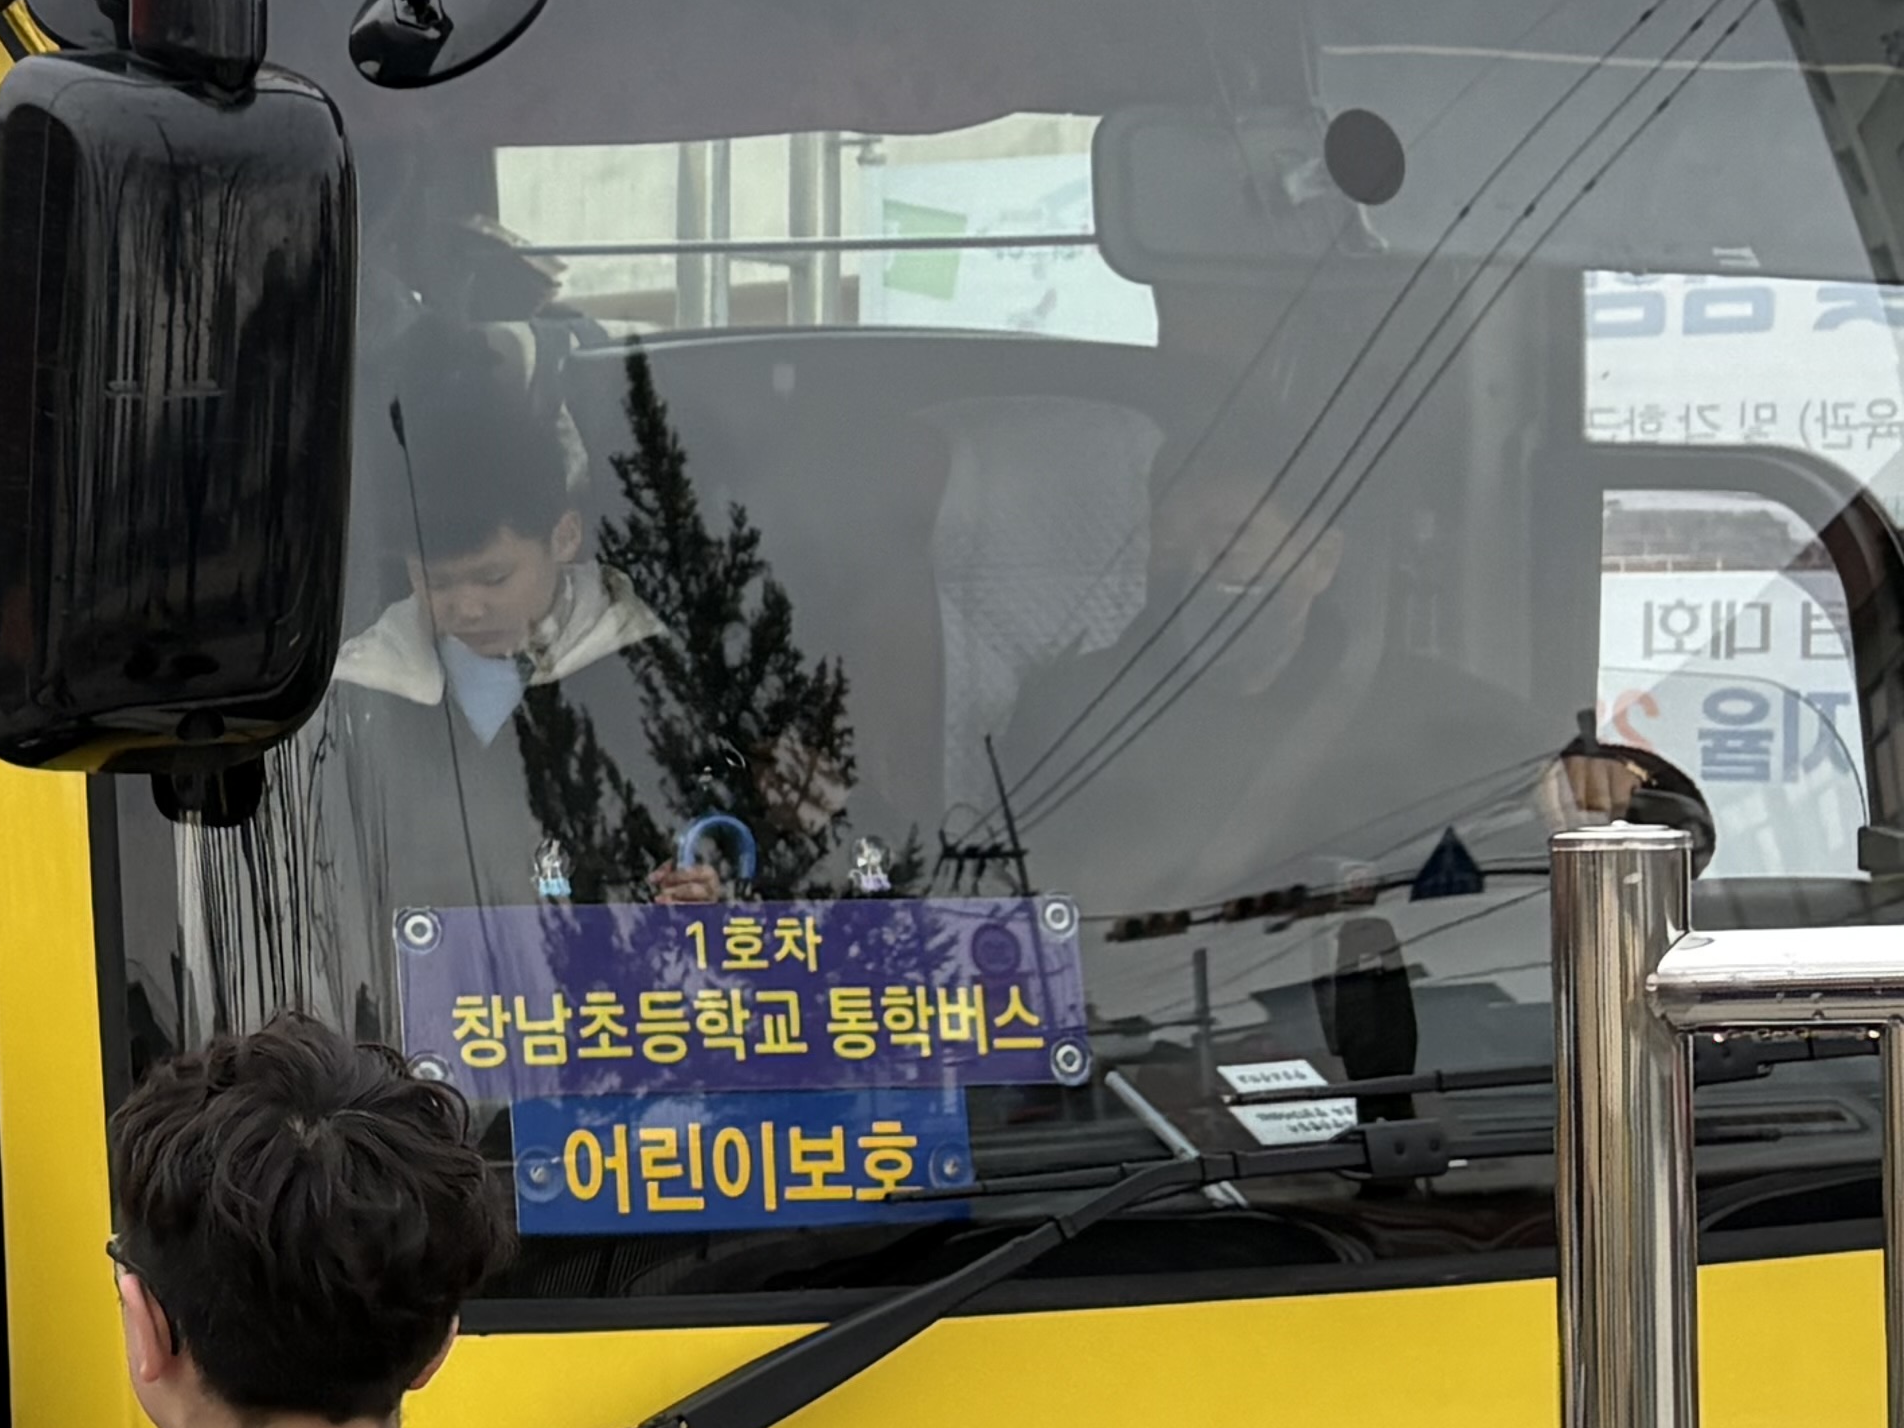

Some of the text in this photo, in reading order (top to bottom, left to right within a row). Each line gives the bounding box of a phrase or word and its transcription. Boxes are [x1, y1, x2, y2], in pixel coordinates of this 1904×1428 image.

[686, 917, 822, 972] 1호차
[451, 983, 1047, 1069] 창남초등학교 통학버스
[562, 1120, 922, 1215] 어린이보호
